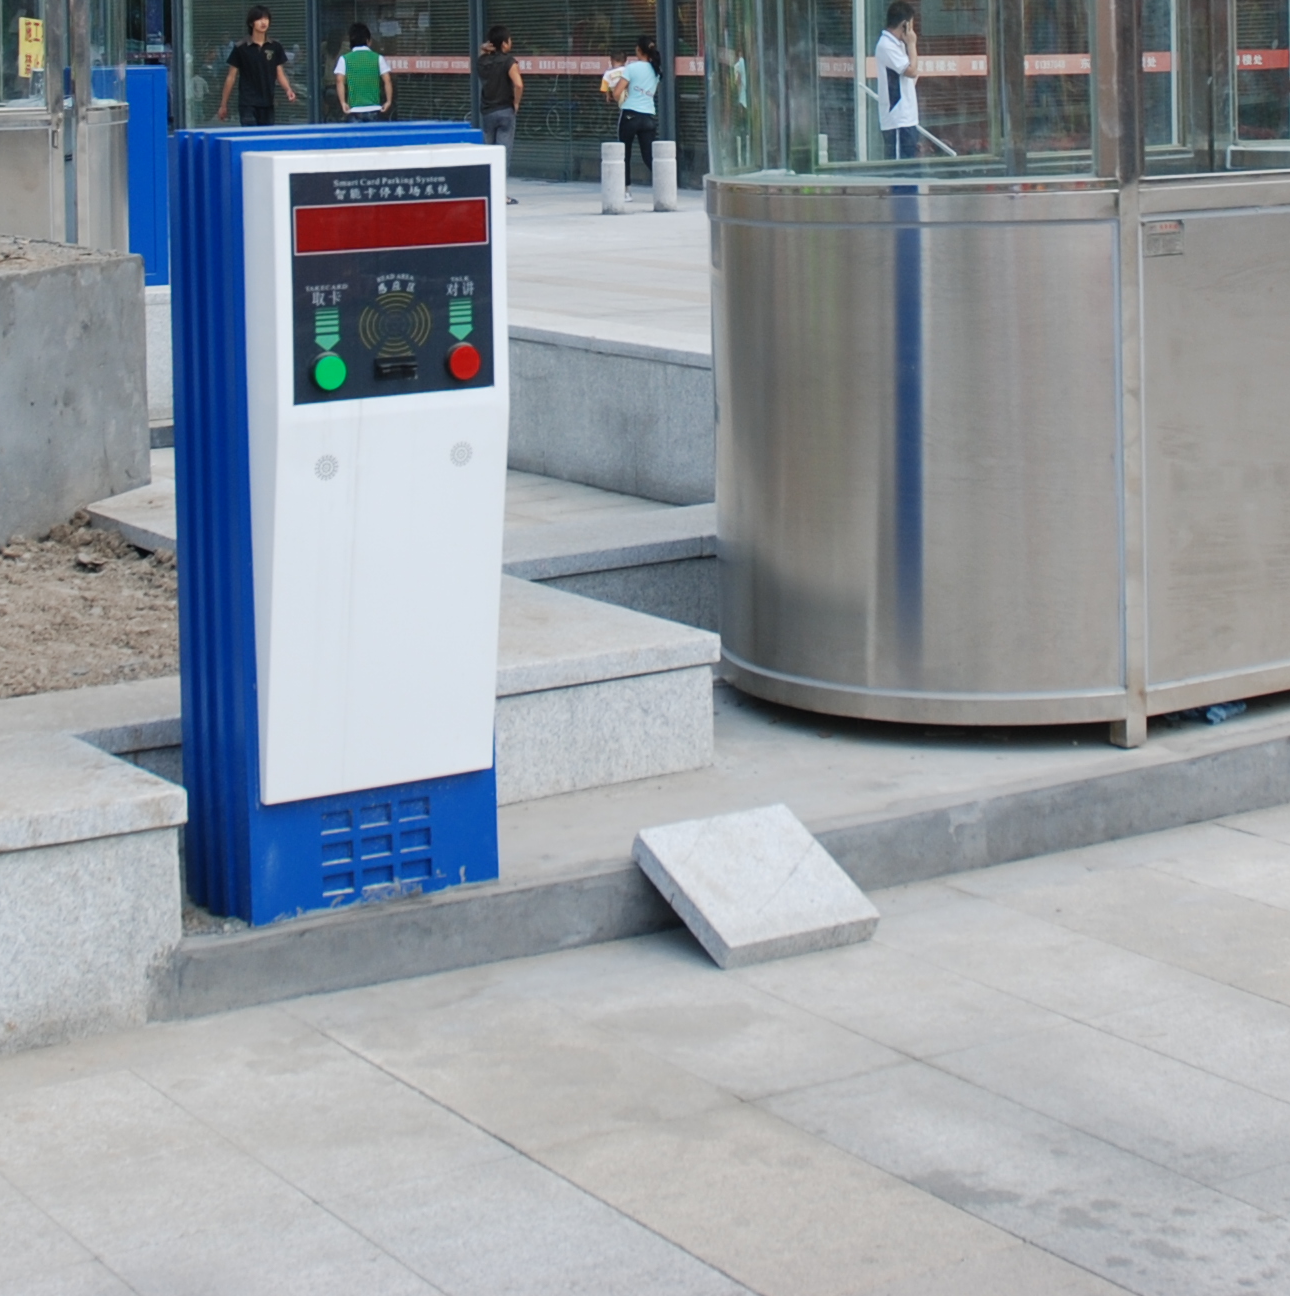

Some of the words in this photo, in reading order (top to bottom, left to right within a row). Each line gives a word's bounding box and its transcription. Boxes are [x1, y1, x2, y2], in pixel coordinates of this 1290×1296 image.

[333, 179, 358, 188] Smart
[359, 178, 380, 187] Card
[382, 176, 414, 186] Parking
[415, 175, 446, 184] System
[334, 183, 451, 201] 智能卡停车场系统
[446, 281, 475, 297] 对讲
[311, 291, 342, 307] 取卡
